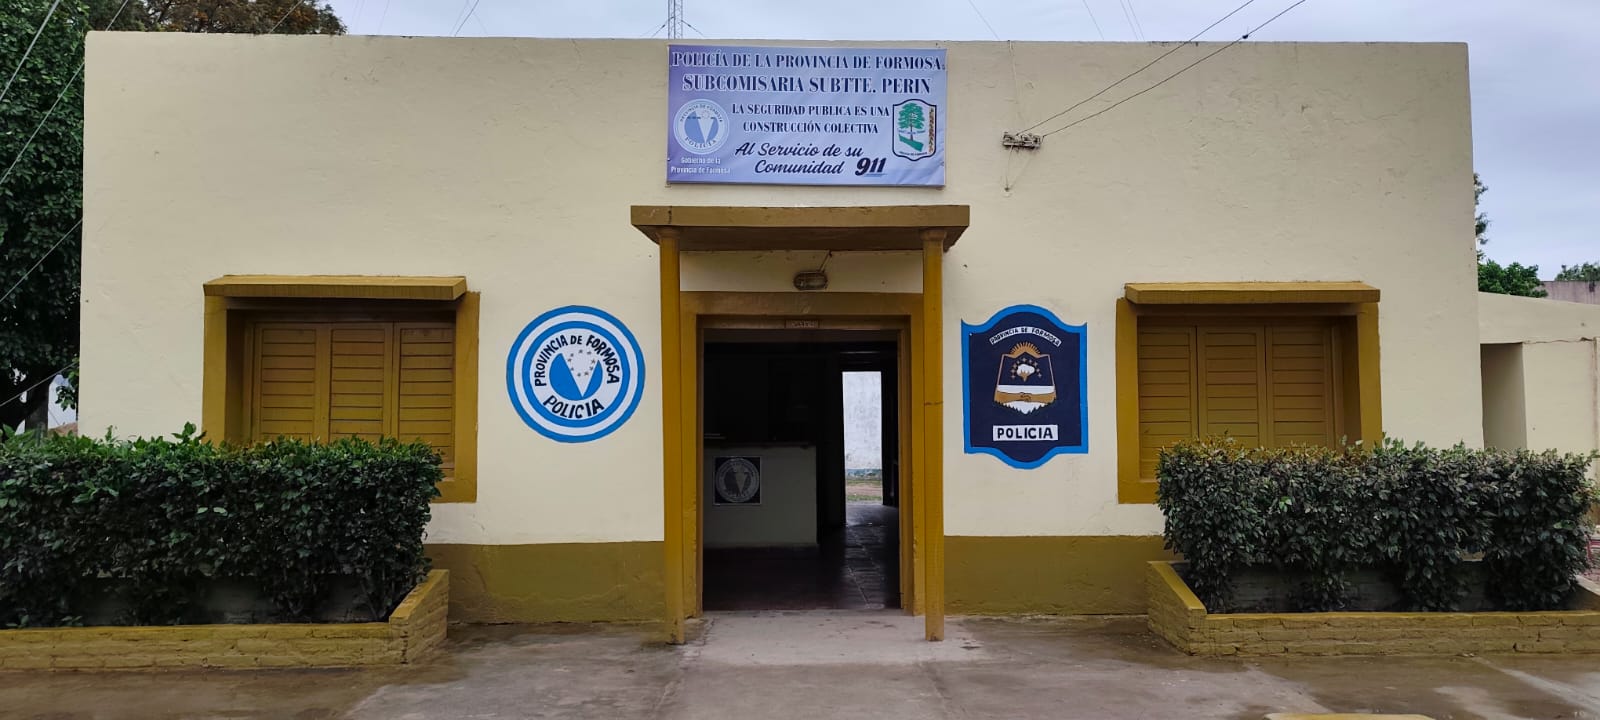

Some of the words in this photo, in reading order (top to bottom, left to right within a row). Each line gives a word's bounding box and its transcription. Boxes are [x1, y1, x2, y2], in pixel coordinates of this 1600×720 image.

[672, 50, 728, 67] POLICÍA
[732, 53, 751, 67] DE
[755, 54, 771, 68] LA
[776, 54, 848, 69] PROVINCIA
[853, 55, 871, 69] DE
[683, 74, 804, 92] SUBCOMISARIA
[809, 77, 876, 93] SUBTTE.
[882, 79, 931, 94] PERIN
[732, 103, 744, 114] LA
[747, 103, 805, 116] SEGURIDAD
[808, 105, 851, 116] PUBLICA
[854, 106, 867, 116] ES
[870, 106, 889, 117] UNA
[743, 120, 820, 133] CONSTRUCCIÓN
[824, 123, 878, 134] COLECTIVA
[735, 142, 756, 156] Al
[757, 142, 820, 157] Servicio
[822, 143, 842, 157] de
[844, 147, 864, 157] su
[754, 159, 845, 174] Comunidad
[855, 157, 887, 177] 911
[990, 328, 1019, 344] PROVINCIA
[1032, 328, 1061, 346] FORMOSA
[534, 334, 569, 387] PROVINCIA
[570, 335, 583, 345] DE
[586, 334, 620, 384] FORMOSA
[543, 395, 604, 419] POLICIA
[997, 427, 1054, 439] POLICIA
